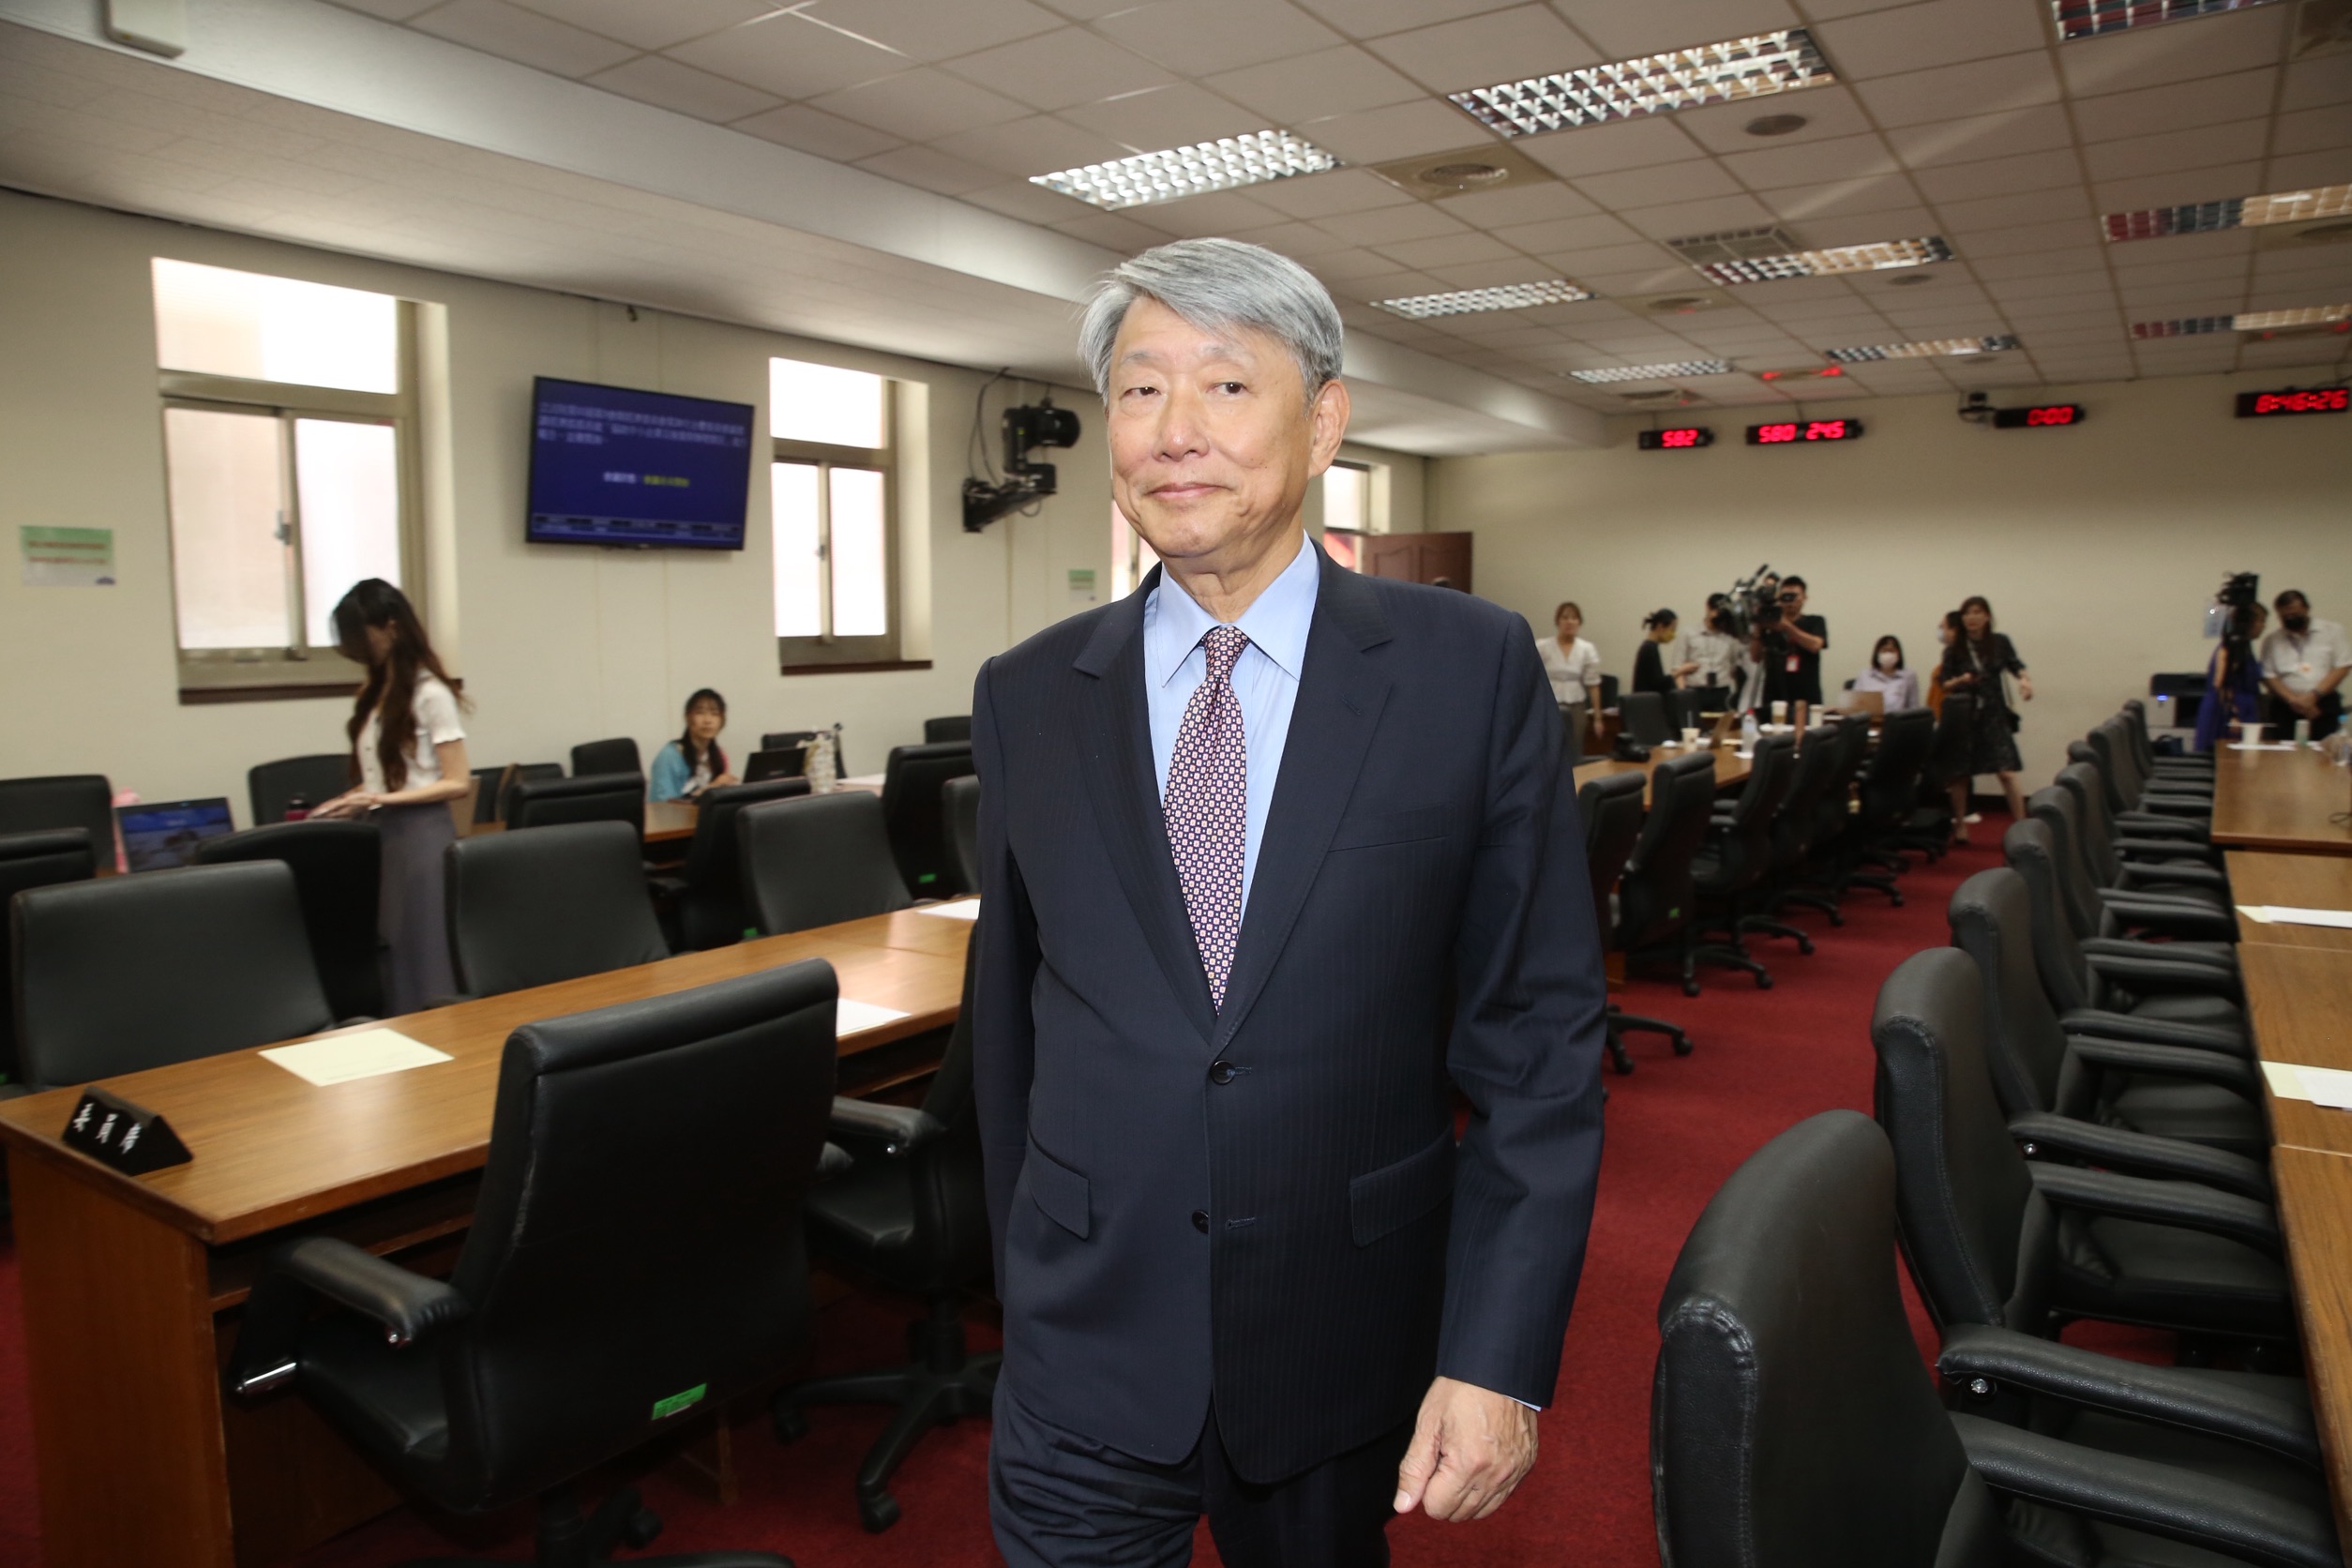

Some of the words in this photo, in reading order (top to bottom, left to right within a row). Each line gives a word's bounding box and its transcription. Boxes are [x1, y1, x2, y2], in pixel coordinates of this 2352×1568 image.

[2254, 389, 2348, 413] 8:46:26
[1662, 429, 1698, 447] 582
[1758, 423, 1797, 444] 580
